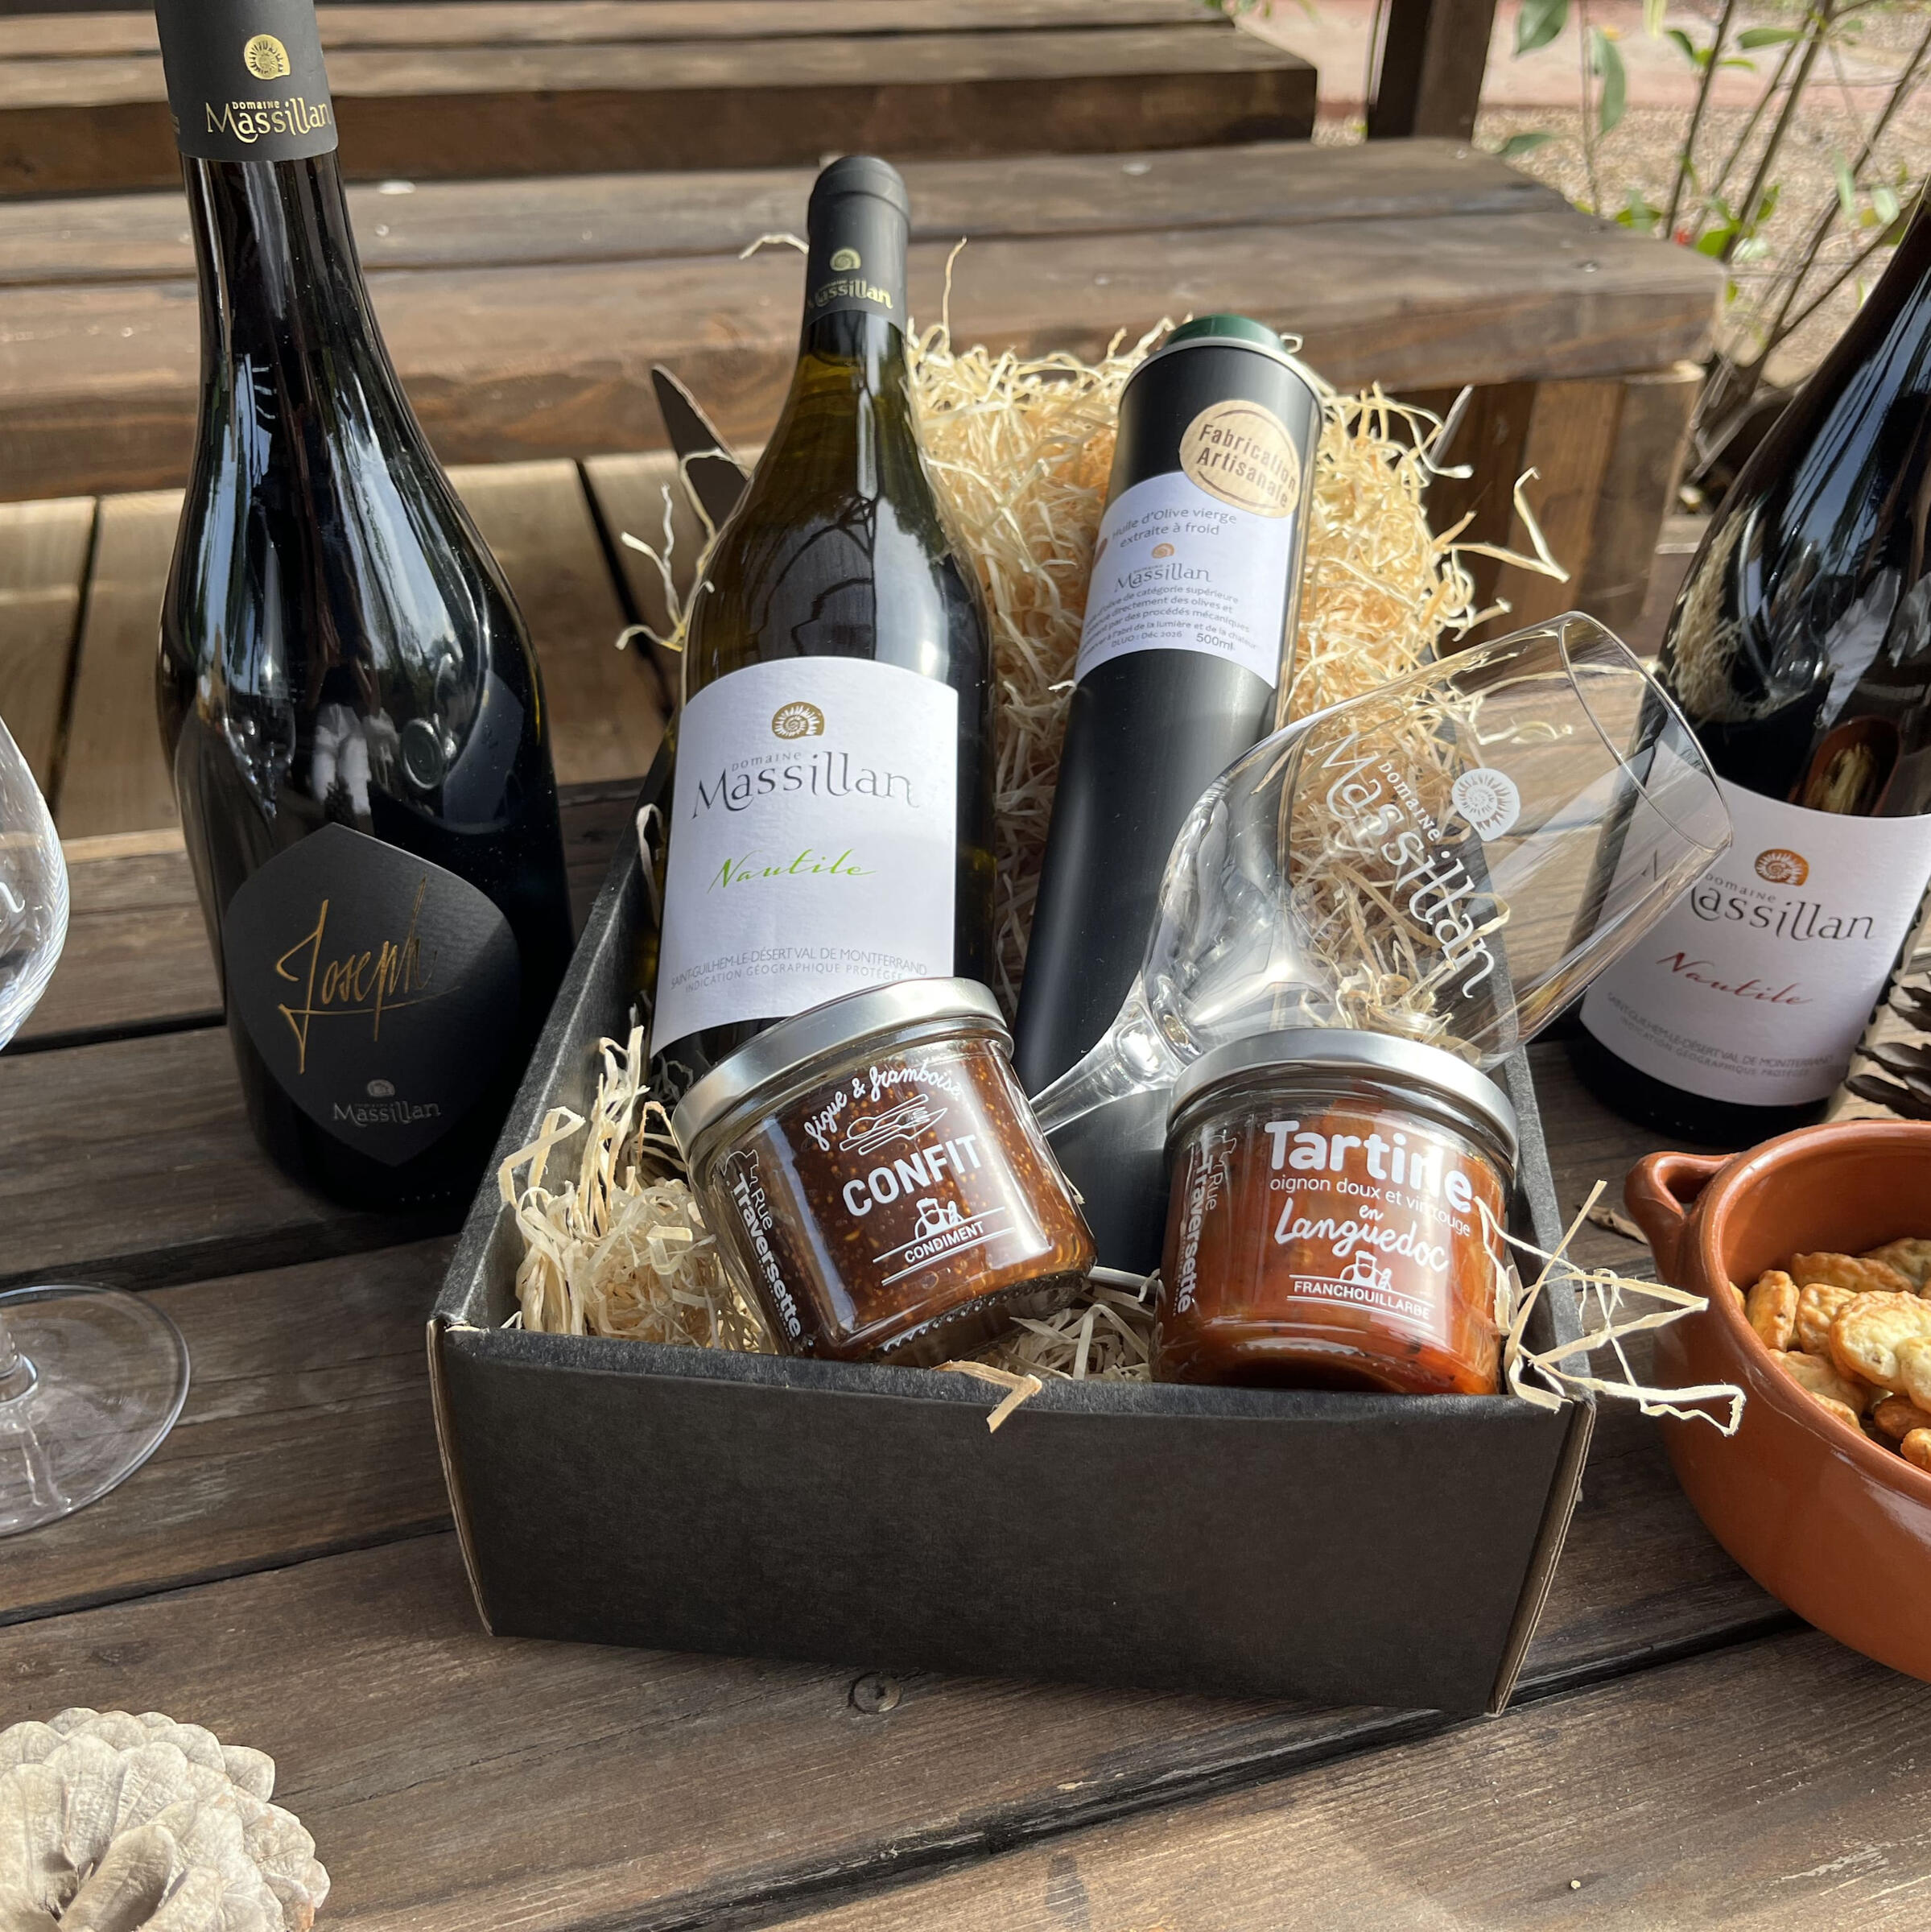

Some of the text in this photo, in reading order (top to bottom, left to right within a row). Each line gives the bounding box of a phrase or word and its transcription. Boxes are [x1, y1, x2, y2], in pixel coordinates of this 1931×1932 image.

[205, 97, 332, 143] Massillan
[1195, 447, 1289, 509] Artisanale
[1197, 423, 1297, 493] Fabrication
[1112, 508, 1237, 539] Huile d'Olive vierge
[1120, 521, 1219, 548] extraite à froid
[1113, 563, 1211, 592] Massillan
[1137, 586, 1183, 598] catégorie
[1186, 587, 1238, 605] supérieure
[1124, 612, 1141, 622] des
[1143, 607, 1190, 618] procédés
[1192, 609, 1249, 633] mécaniques
[1157, 619, 1191, 628] lumière
[1194, 621, 1203, 630] et
[1206, 625, 1217, 633] de
[1170, 596, 1189, 605] des
[1191, 597, 1220, 610] olives
[1222, 602, 1232, 613] et
[691, 750, 919, 819] Massillan
[708, 848, 877, 894] Nautile
[1307, 731, 1495, 998] Massillan
[274, 869, 461, 1075] Joseph
[685, 968, 742, 993] INDICATION
[745, 961, 840, 976] GÉOGRAPHIQUE
[794, 947, 817, 960] VAL
[819, 947, 836, 960] DE
[840, 947, 927, 976] MONTFERRAND
[1656, 952, 1816, 1006] Nautile
[332, 1100, 442, 1128] Massillan
[804, 1058, 963, 1151] figue & framboise
[842, 1133, 981, 1217] CONFIT
[1264, 1120, 1472, 1213] Tartine
[750, 1187, 774, 1232] Rue
[1204, 1171, 1226, 1211] Rue
[1269, 1174, 1331, 1194] oignon
[1336, 1177, 1381, 1200] doux
[1385, 1190, 1402, 1206] et
[1359, 1203, 1384, 1221] en
[732, 1173, 802, 1339] Traversette
[904, 1220, 984, 1264] CONDIMENT
[1176, 1154, 1214, 1314] Traversette
[1274, 1197, 1450, 1273] Languedoc
